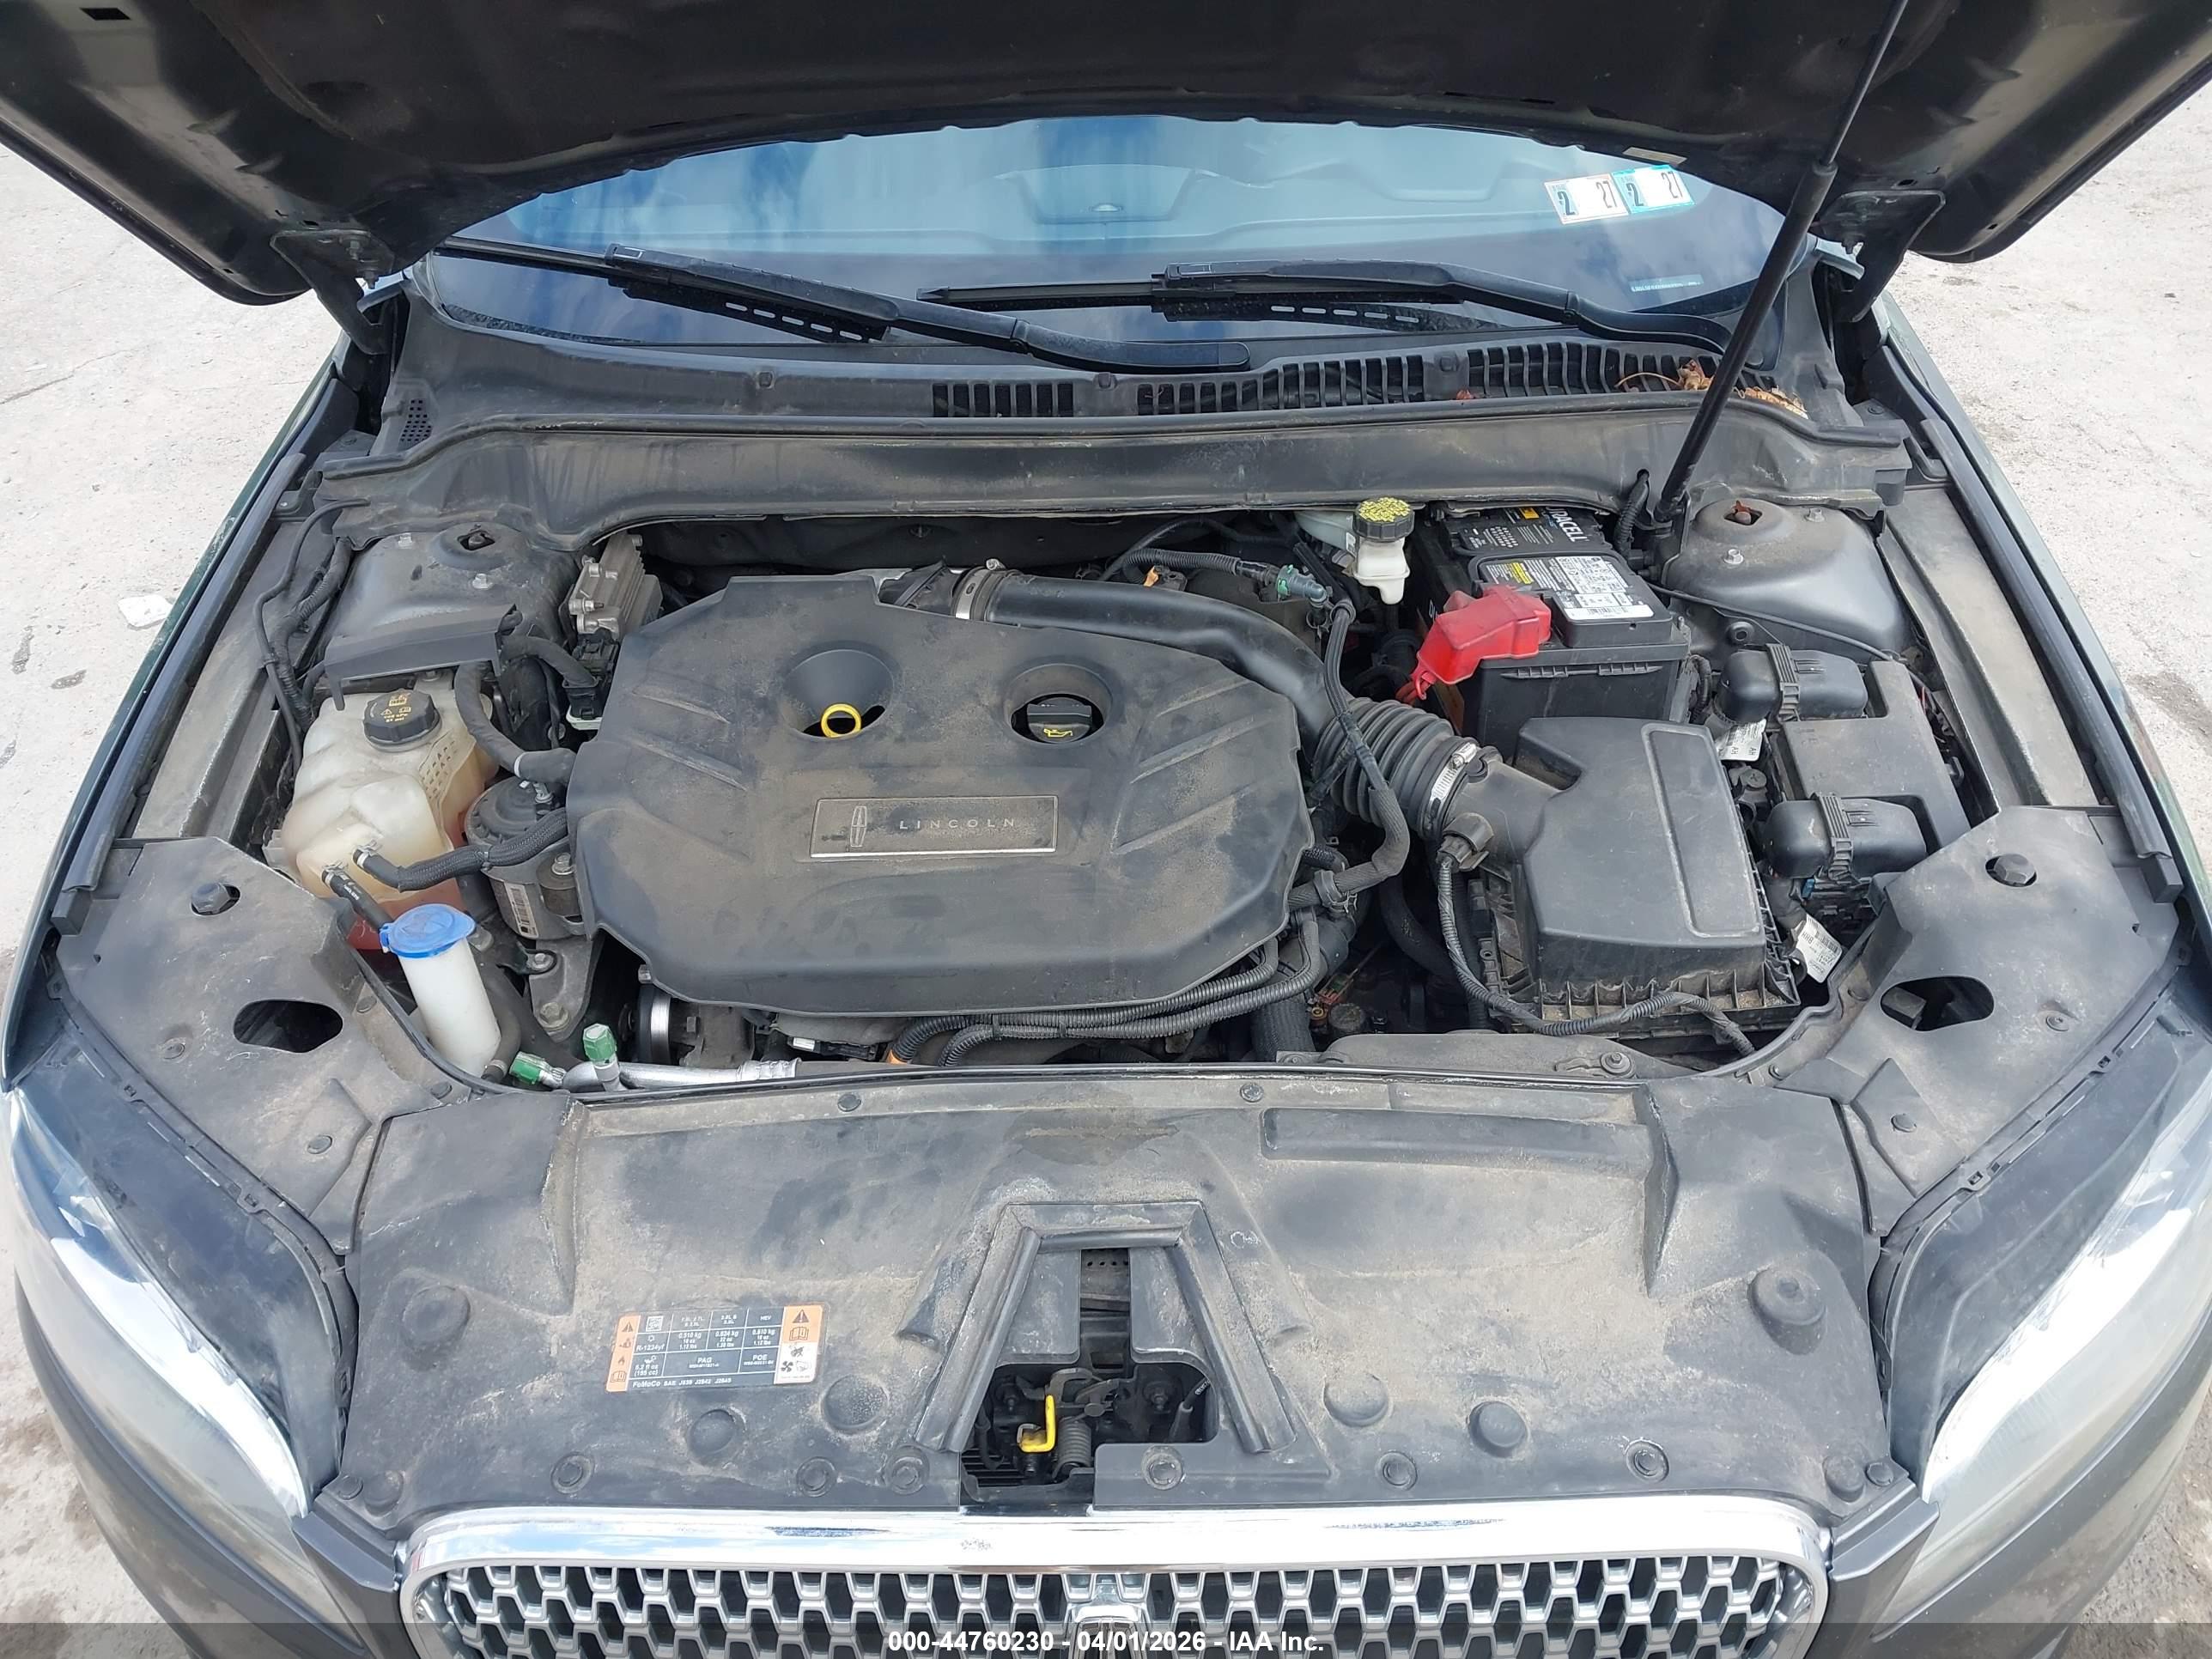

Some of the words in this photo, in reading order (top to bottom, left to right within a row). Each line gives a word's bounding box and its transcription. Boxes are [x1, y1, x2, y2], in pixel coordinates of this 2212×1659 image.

[1557, 191, 1575, 216] 2
[1595, 180, 1618, 209] 27
[1626, 182, 1644, 207] 2
[1661, 171, 1683, 198] 27
[1545, 507, 1588, 542] URACELL
[900, 818, 1014, 830] LINCOLN
[635, 1343, 665, 1352] R-1234yf
[632, 1380, 661, 1389] FoMoCo
